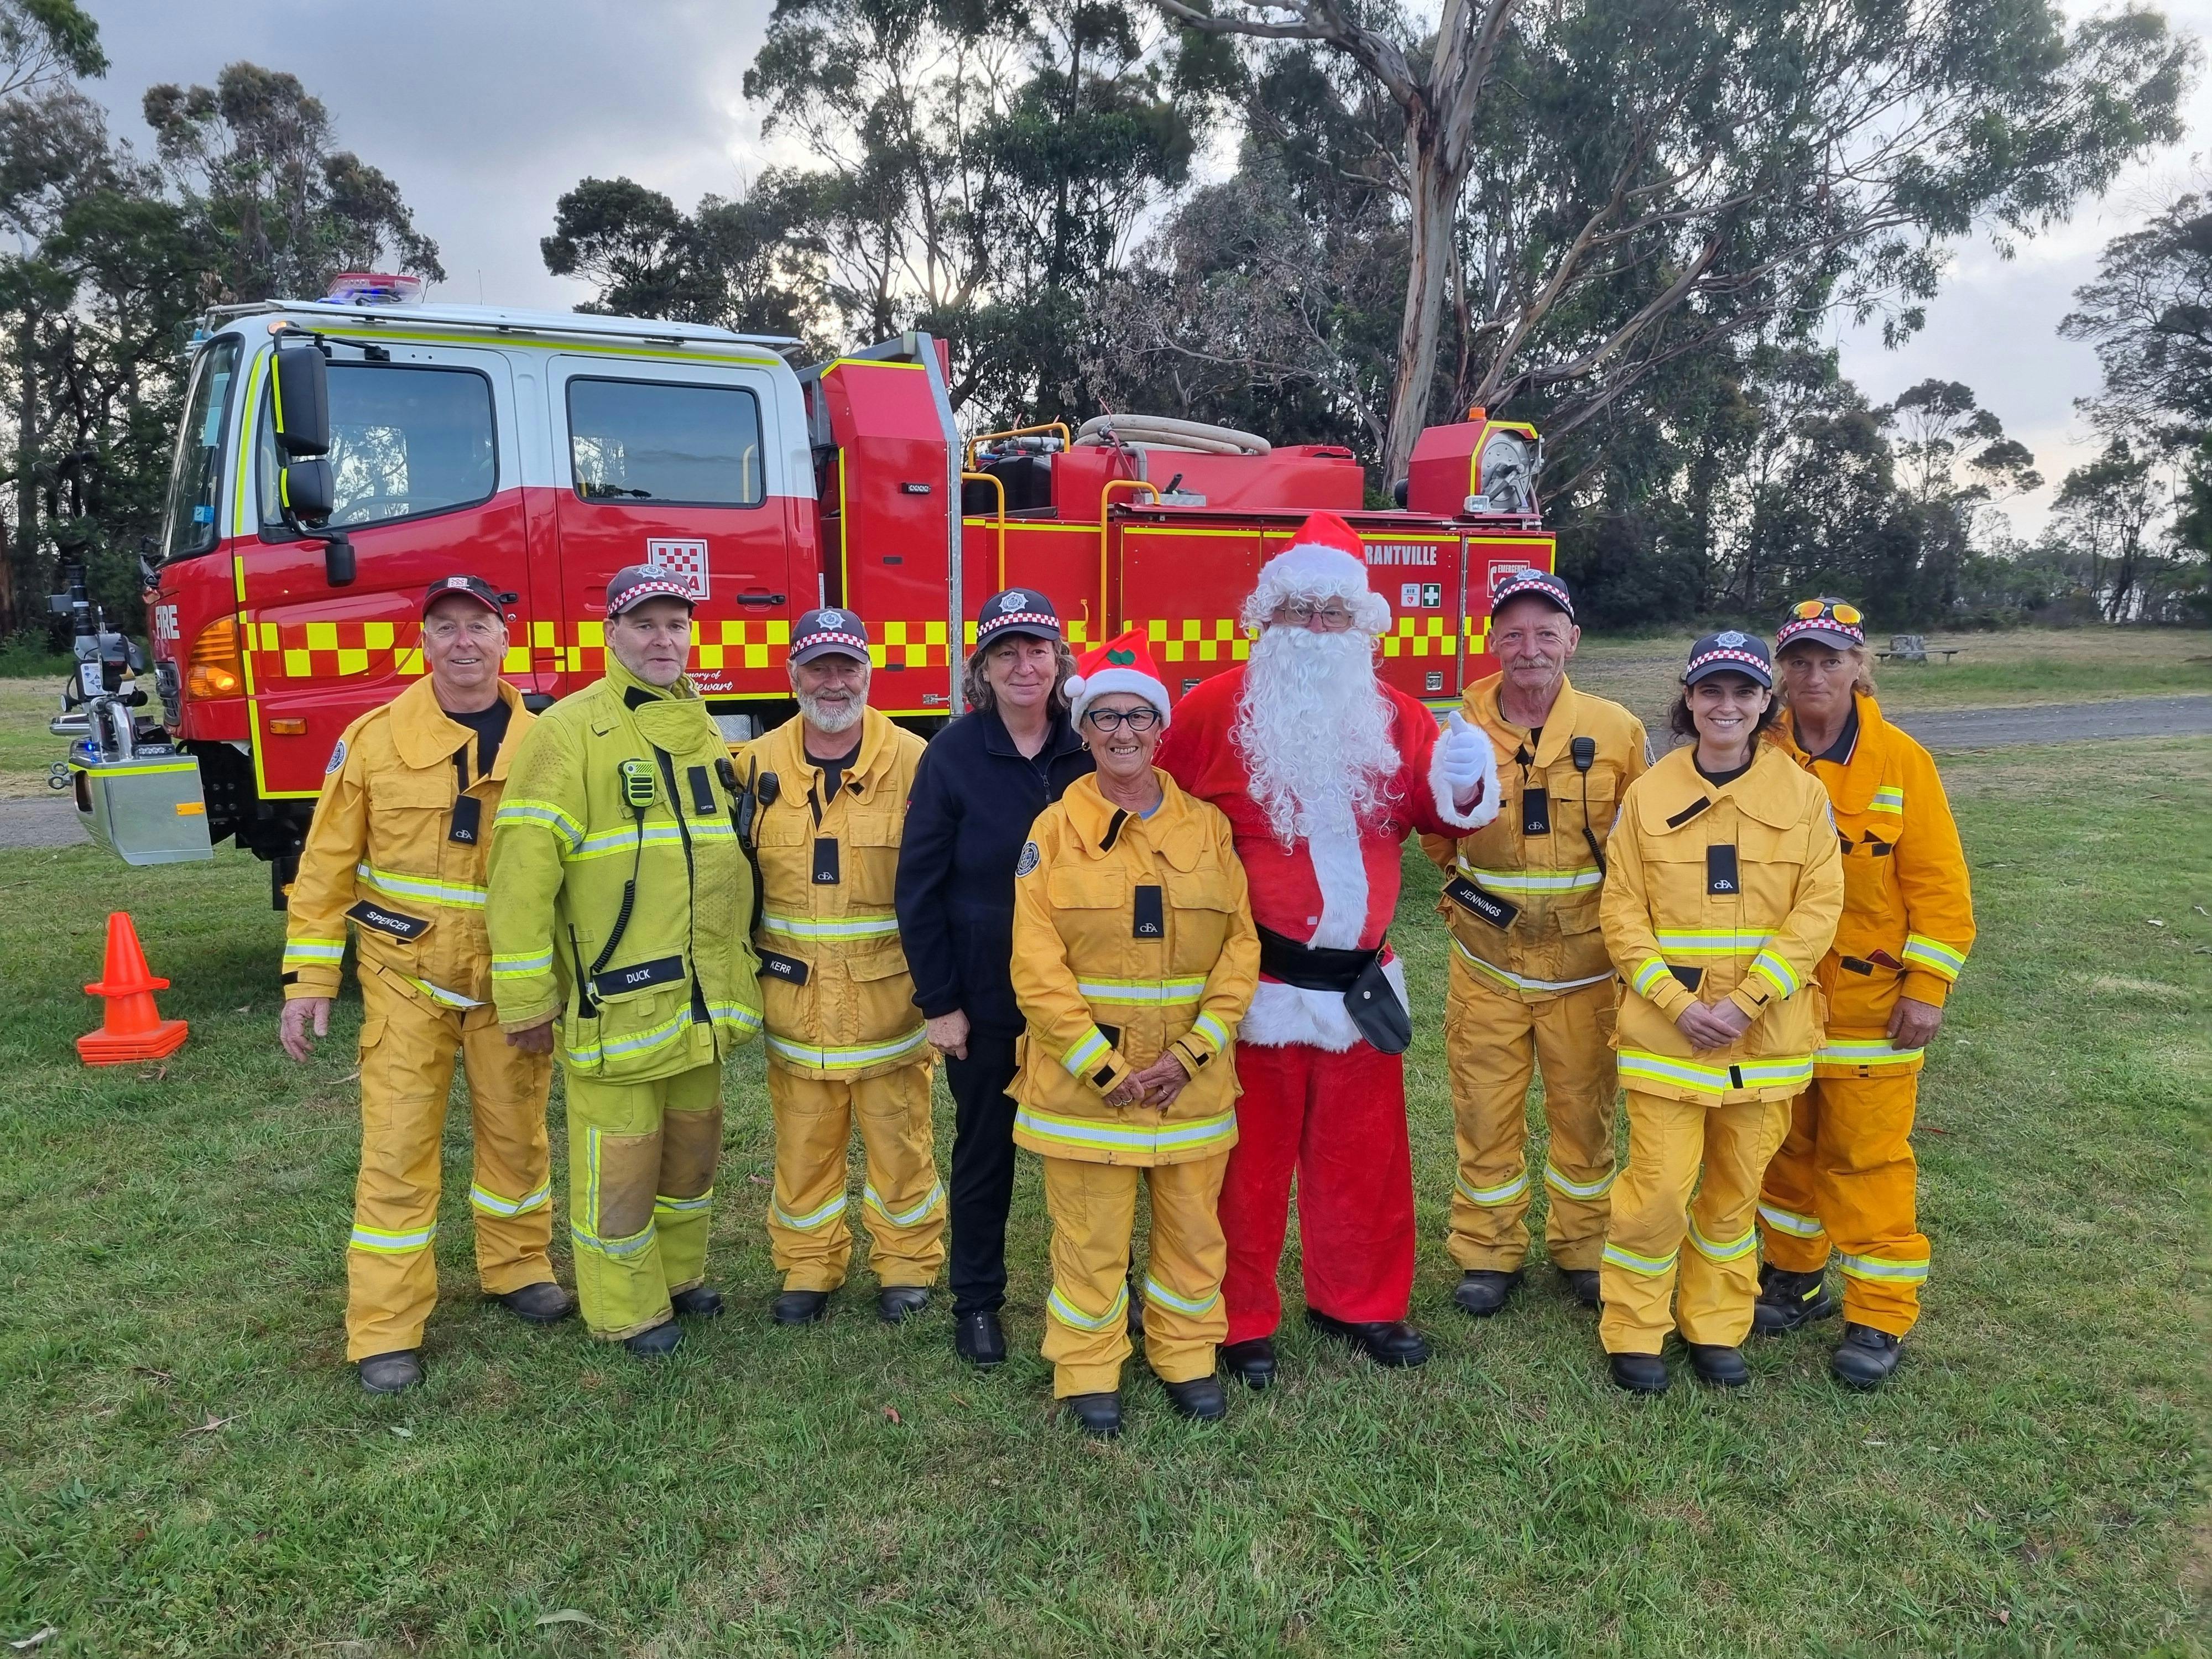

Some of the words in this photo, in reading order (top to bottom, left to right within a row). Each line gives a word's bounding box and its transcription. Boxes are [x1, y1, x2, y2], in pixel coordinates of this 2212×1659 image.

[155, 605, 180, 639] FIRE
[711, 670, 721, 680] of
[1528, 821, 1545, 830] CFA
[456, 830, 473, 839] CFA
[817, 872, 834, 880] CFA
[1714, 879, 1733, 889] CFA
[1460, 889, 1501, 917] JENNINGS
[367, 911, 411, 932] SPENCER
[1140, 922, 1158, 932] CFA
[770, 960, 791, 974] KERR
[626, 968, 650, 984] DUCK
